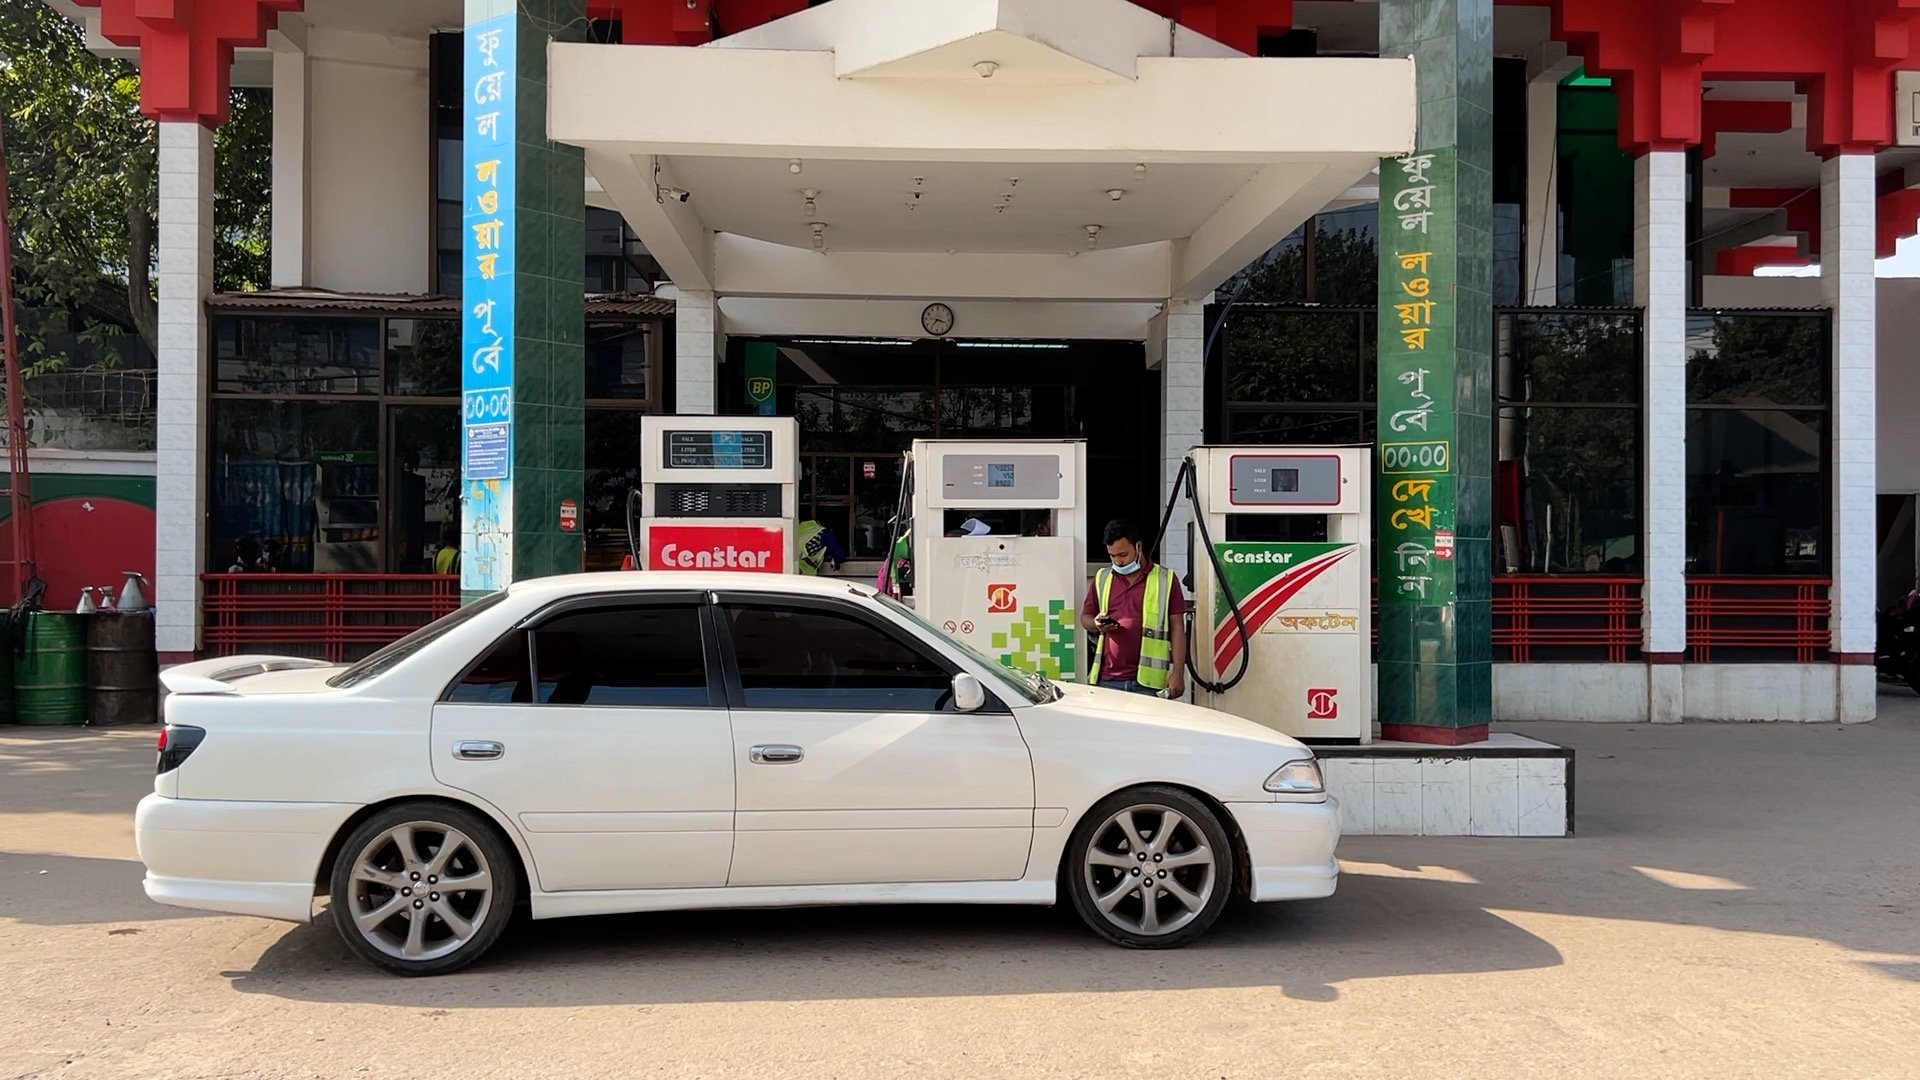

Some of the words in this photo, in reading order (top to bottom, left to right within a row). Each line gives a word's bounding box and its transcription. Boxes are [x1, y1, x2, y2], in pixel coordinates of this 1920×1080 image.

[752, 381, 770, 394] BP
[661, 543, 771, 568] Censtar
[1223, 549, 1293, 564] Censtar
[1277, 612, 1358, 631] অকটেন
